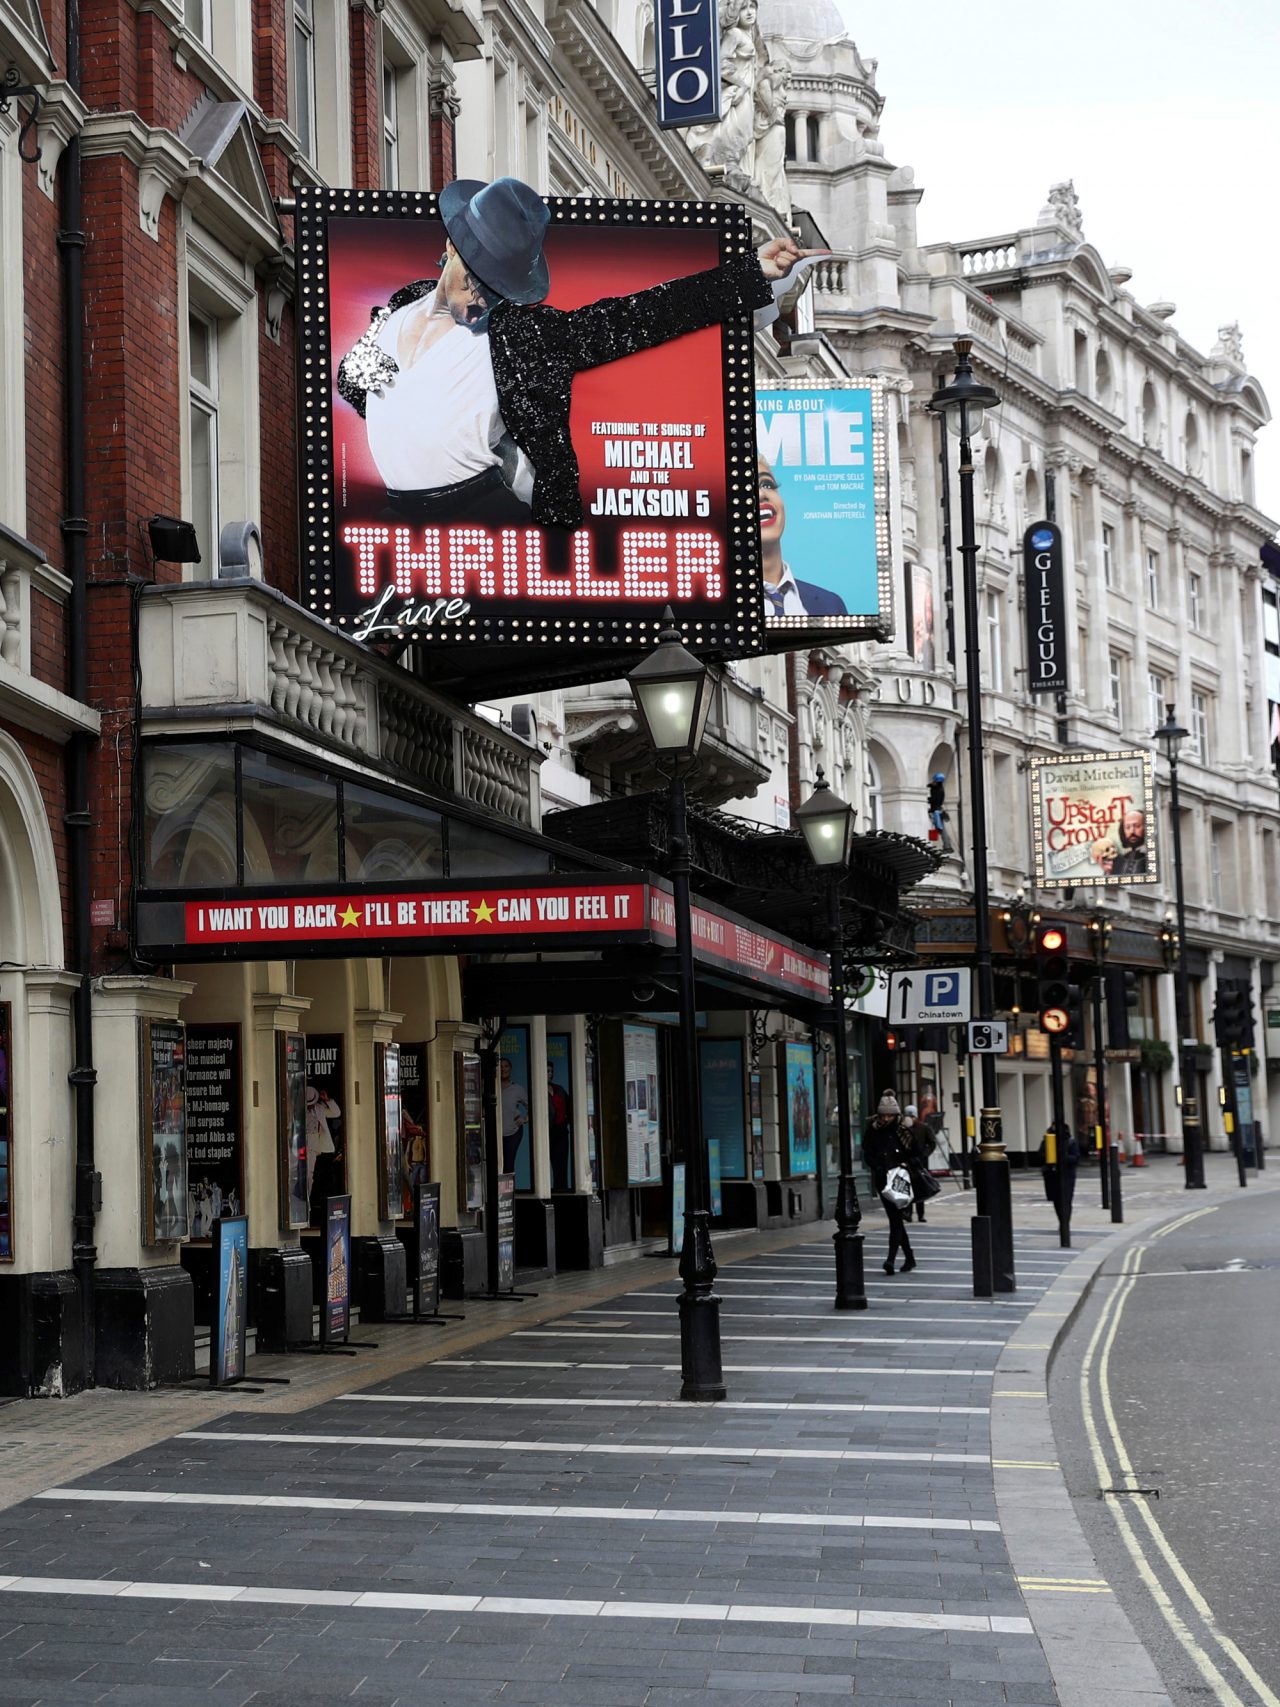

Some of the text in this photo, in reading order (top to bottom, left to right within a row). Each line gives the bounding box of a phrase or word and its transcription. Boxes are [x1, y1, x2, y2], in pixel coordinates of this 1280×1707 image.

[787, 398, 825, 411] ABOUT
[591, 421, 707, 437] FEATURING THE SONGS OF
[604, 439, 695, 469] MICHAEL
[630, 470, 670, 484] AND THE
[794, 473, 801, 481] BY
[803, 473, 815, 481] DAN
[817, 473, 846, 481] GILLESPIE
[840, 483, 865, 491] MACRAE
[590, 487, 710, 517] JACKSON 5
[857, 502, 866, 511] by
[803, 511, 866, 520] JONATHAN BUTTERELL
[344, 526, 722, 598] THRILLER
[351, 583, 471, 641] Live
[1034, 552, 1057, 679] GIELGUD
[1031, 680, 1065, 689] THEATRE
[1045, 765, 1139, 784] David Mitchell
[198, 894, 630, 932] I WANT YOU BACK I'LL BE THERE CAN YOU FEEL IT
[931, 976, 954, 1003] P
[918, 1011, 963, 1019] Chinatown
[186, 1037, 233, 1051] sheer majesty
[188, 1053, 226, 1065] the musical
[218, 1068, 231, 1080] will
[208, 1084, 223, 1096] that
[192, 1100, 230, 1113] MJ-homage
[197, 1117, 225, 1129] surpass
[195, 1131, 208, 1143] and
[209, 1131, 224, 1143] Abba
[226, 1132, 235, 1143] as
[194, 1146, 207, 1159] End
